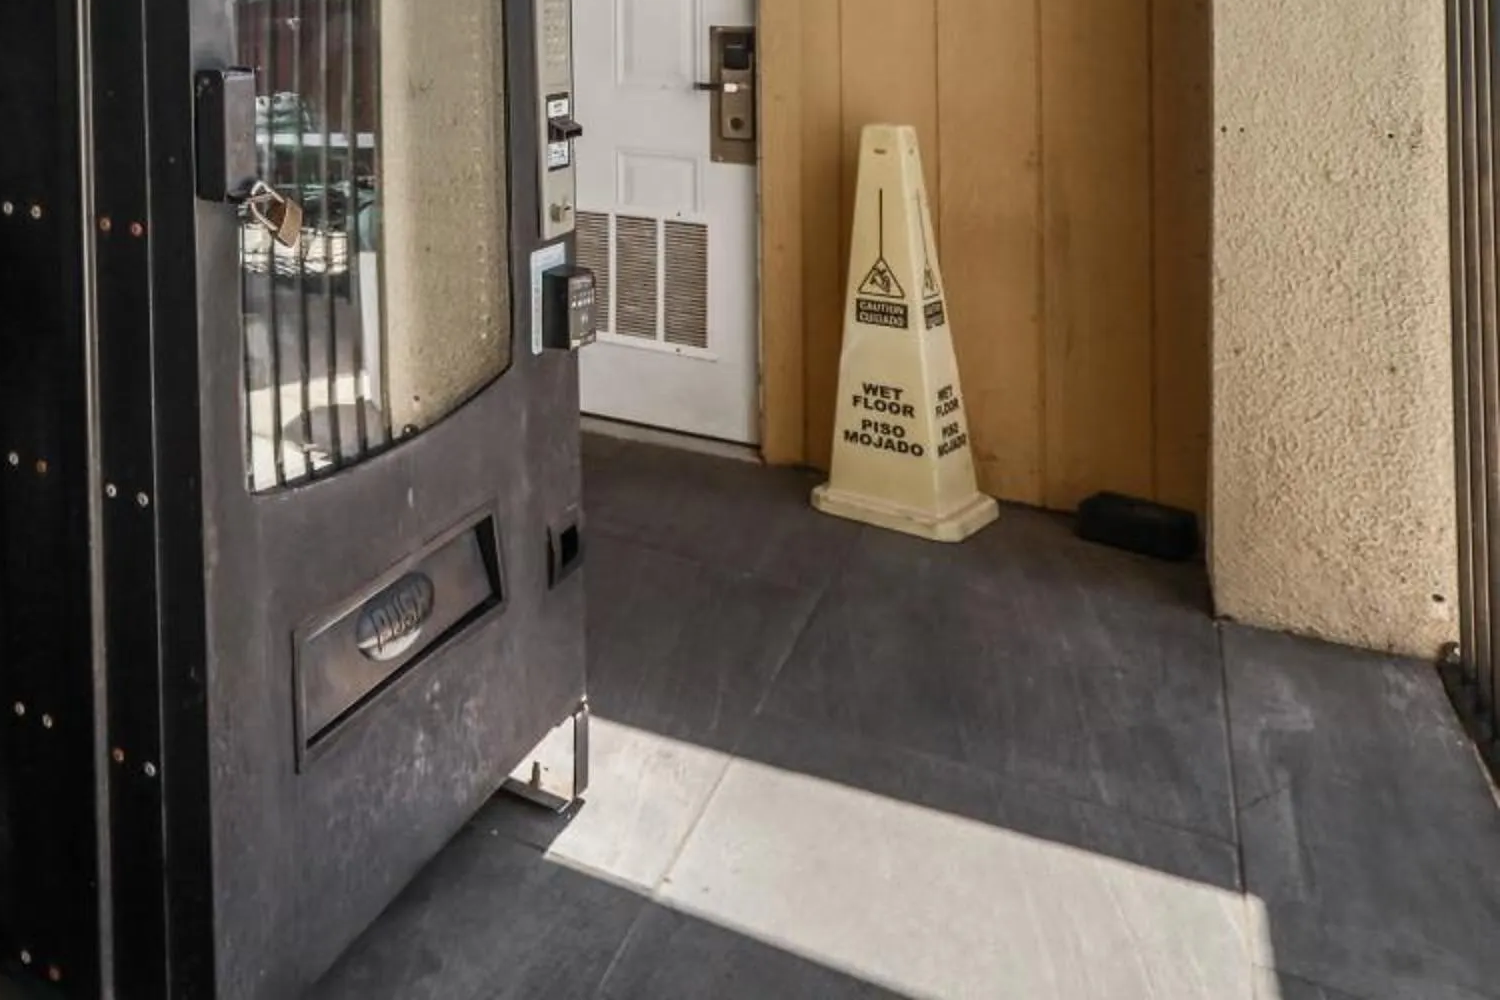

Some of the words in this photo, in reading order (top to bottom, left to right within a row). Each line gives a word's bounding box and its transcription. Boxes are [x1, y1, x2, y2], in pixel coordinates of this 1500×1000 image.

[863, 382, 904, 401] WET
[852, 395, 915, 419] FLOOR
[861, 419, 905, 438] PISO
[843, 430, 924, 457] MOJADO
